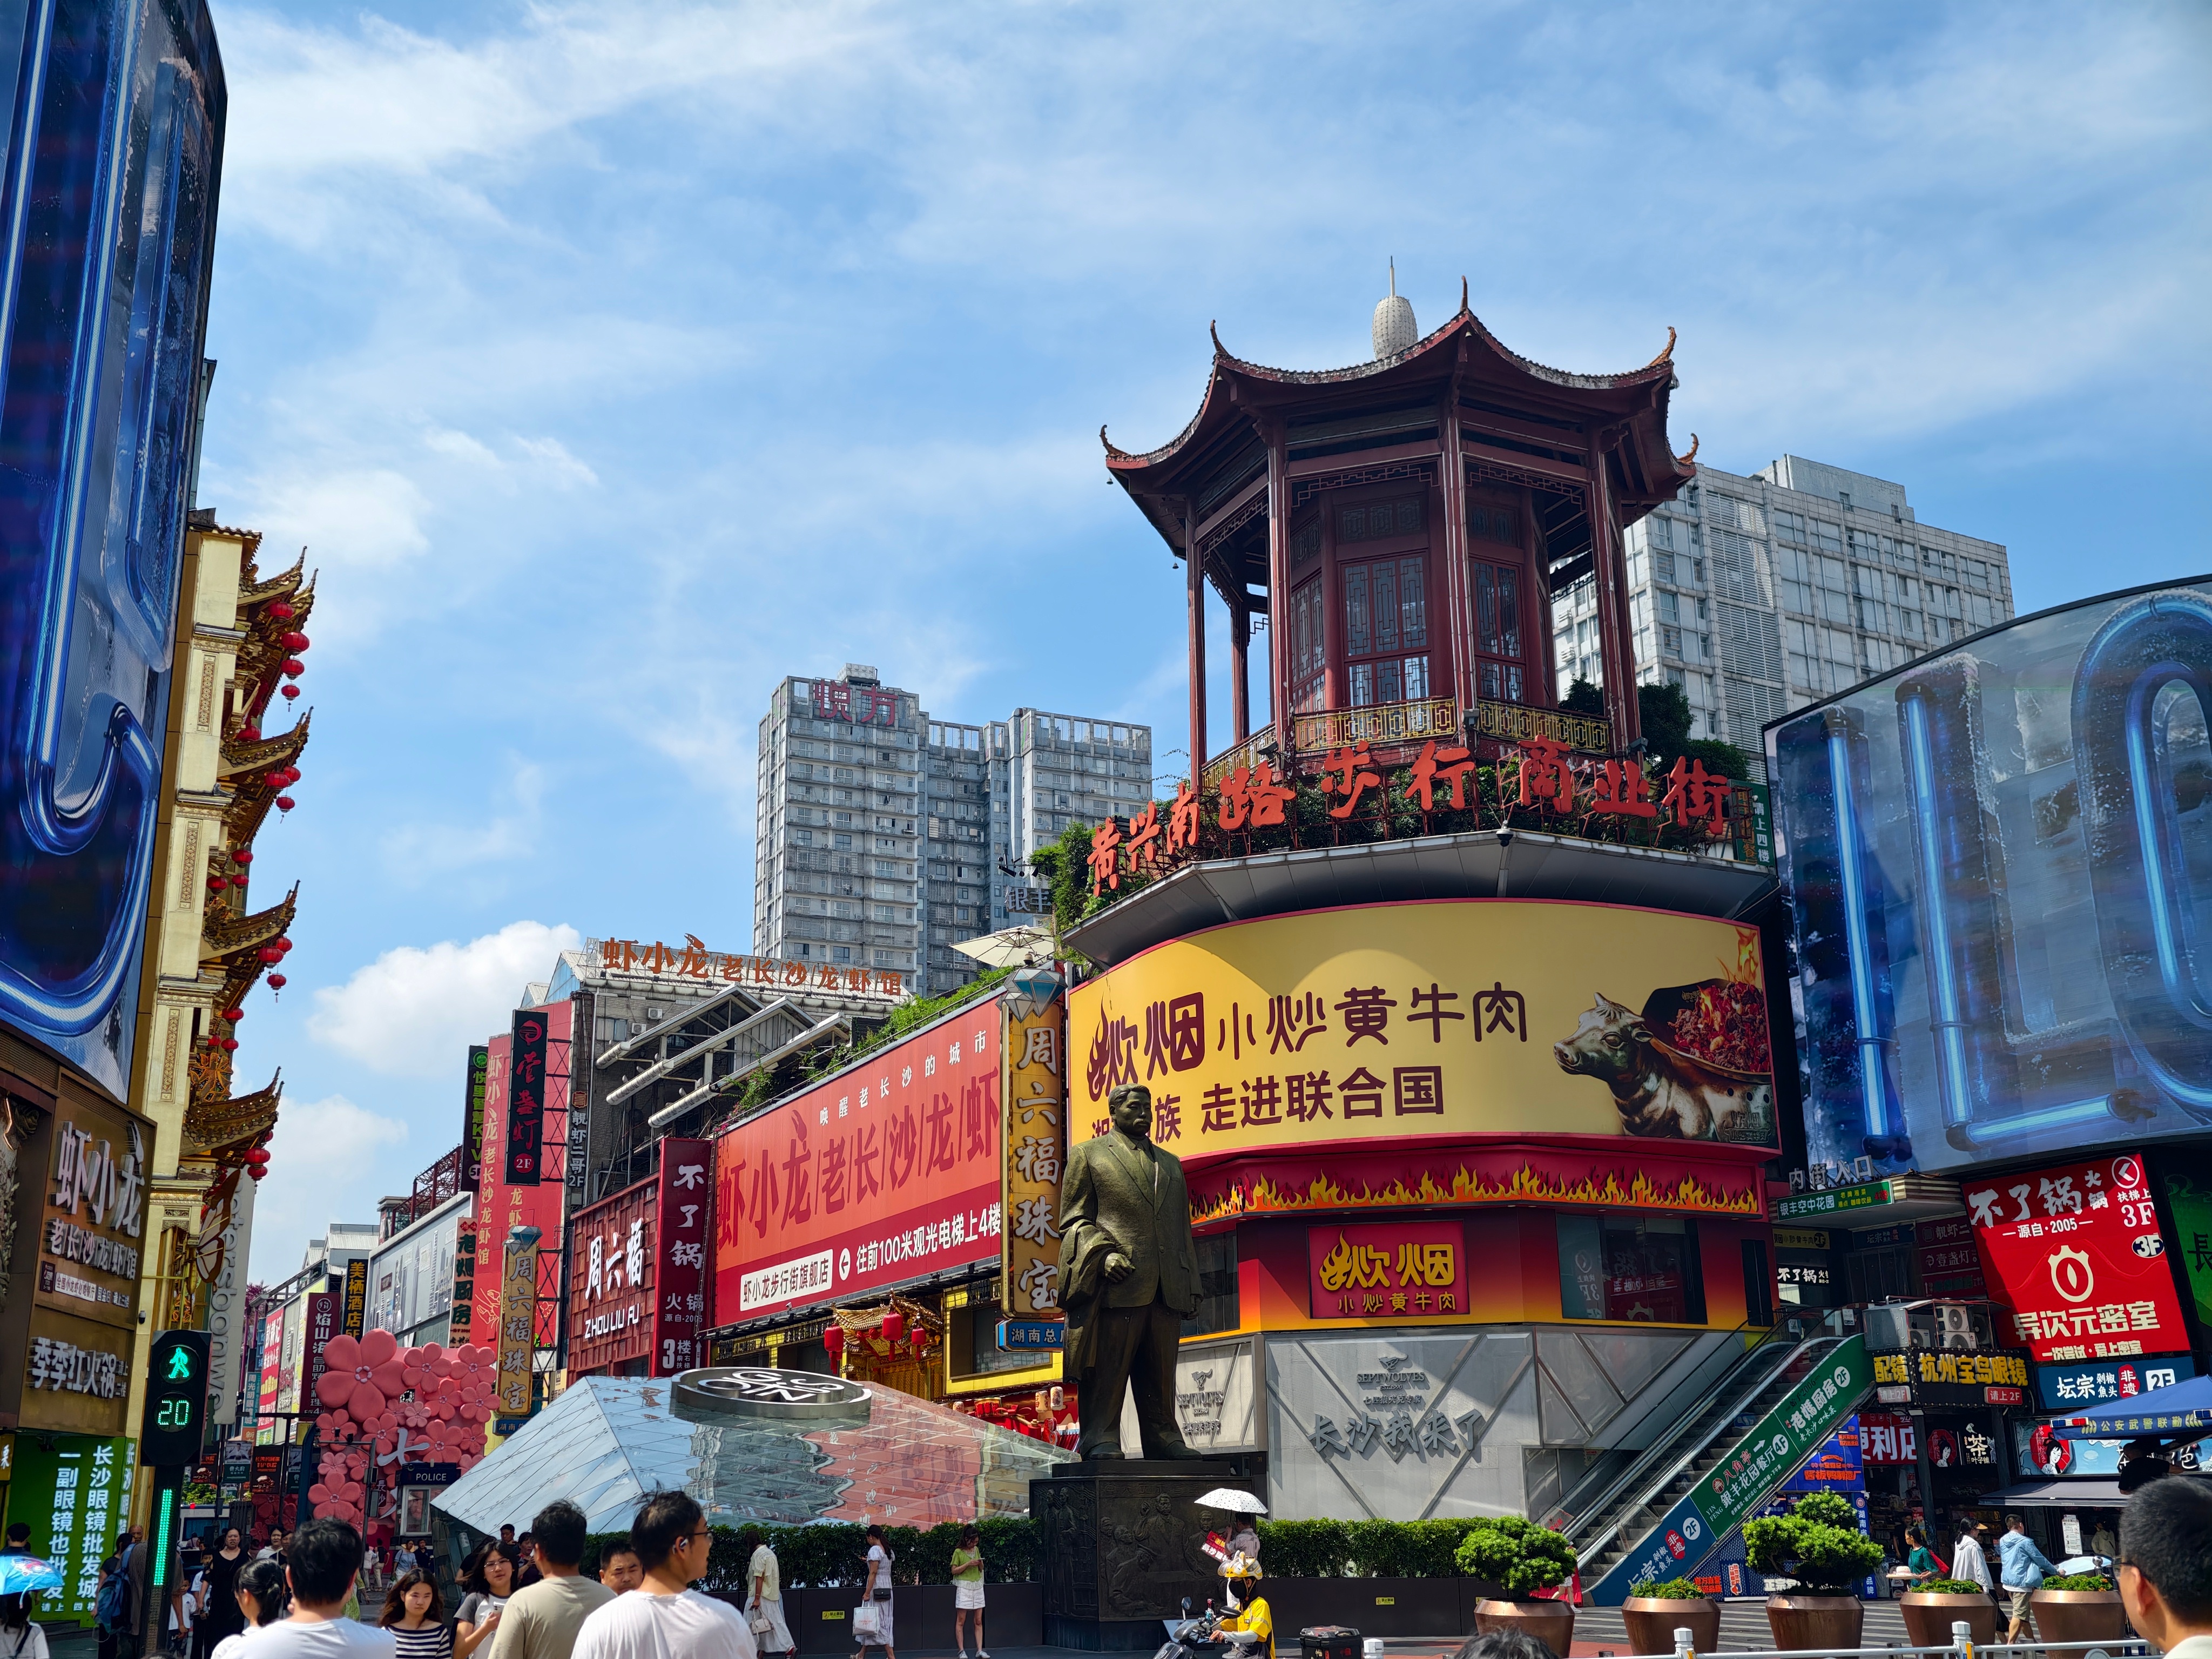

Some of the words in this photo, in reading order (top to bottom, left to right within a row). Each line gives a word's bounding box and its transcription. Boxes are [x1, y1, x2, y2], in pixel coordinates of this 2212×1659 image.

[814, 679, 898, 726] 悦方
[1755, 802, 1770, 862] 请上四楼
[1006, 887, 1051, 913] 银丰
[1217, 981, 1527, 1061] 小炒黄牛肉
[820, 1030, 987, 1127] 唤醒老长沙的城市
[1201, 1065, 1444, 1135] 走进联合国
[477, 1053, 502, 1265] 虾小龙老长沙龙虾馆
[516, 1158, 532, 1169] 2F
[1015, 1027, 1060, 1311] 周六福珠宝
[1789, 1155, 1873, 1190] 内街入口
[53, 1121, 145, 1238] 虾小龙
[569, 1176, 584, 1186] 2F
[2117, 1188, 2152, 1203] 扶梯上
[1780, 1195, 1835, 1216] 银丰空中花园
[1969, 1176, 2082, 1229] 不了锅
[2085, 1170, 2108, 1210] 火锅
[2121, 1202, 2155, 1227] 3F
[669, 1164, 704, 1270] 不了锅
[856, 1203, 1001, 1274] 往前100米观光电梯上4楼
[2136, 1235, 2160, 1257] 3F
[585, 1218, 644, 1300] 周六福
[1777, 1267, 1817, 1284] 不了锅
[345, 1262, 366, 1327] 美栖酒店
[743, 1257, 830, 1304] 虾小龙步行街旗舰店
[665, 1293, 704, 1311] 火锅
[1338, 1292, 1456, 1313] 小炒黄牛肉
[503, 1256, 534, 1410] 周六福珠宝
[585, 1315, 610, 1339] ZHOU
[611, 1308, 624, 1331] LIU
[628, 1303, 640, 1326] FU
[2014, 1301, 2161, 1341] 异次元密室
[31, 1337, 116, 1399] 季季红火锅
[1357, 1372, 1425, 1382] SEPTWOLVES
[1837, 1370, 1847, 1384] 2F
[1874, 1356, 1908, 1383] 配镜
[1919, 1353, 2028, 1386] 杭州宝岛眼镜
[2120, 1369, 2137, 1397] 非遗
[2057, 1374, 2095, 1399] 坛宗
[158, 1400, 189, 1426] 20
[2101, 1416, 2182, 1431] 公安武警联勤
[1308, 1408, 1486, 1457] 长沙我来了
[1775, 1437, 1787, 1452] 4F
[1966, 1434, 1988, 1456] 茶
[1723, 1449, 1752, 1486] 八角亭
[77, 1445, 114, 1599] 长沙眼镜批发城
[1706, 1504, 1716, 1516] YIN
[1709, 1507, 1723, 1522] FENG
[1685, 1520, 1697, 1537] 2F
